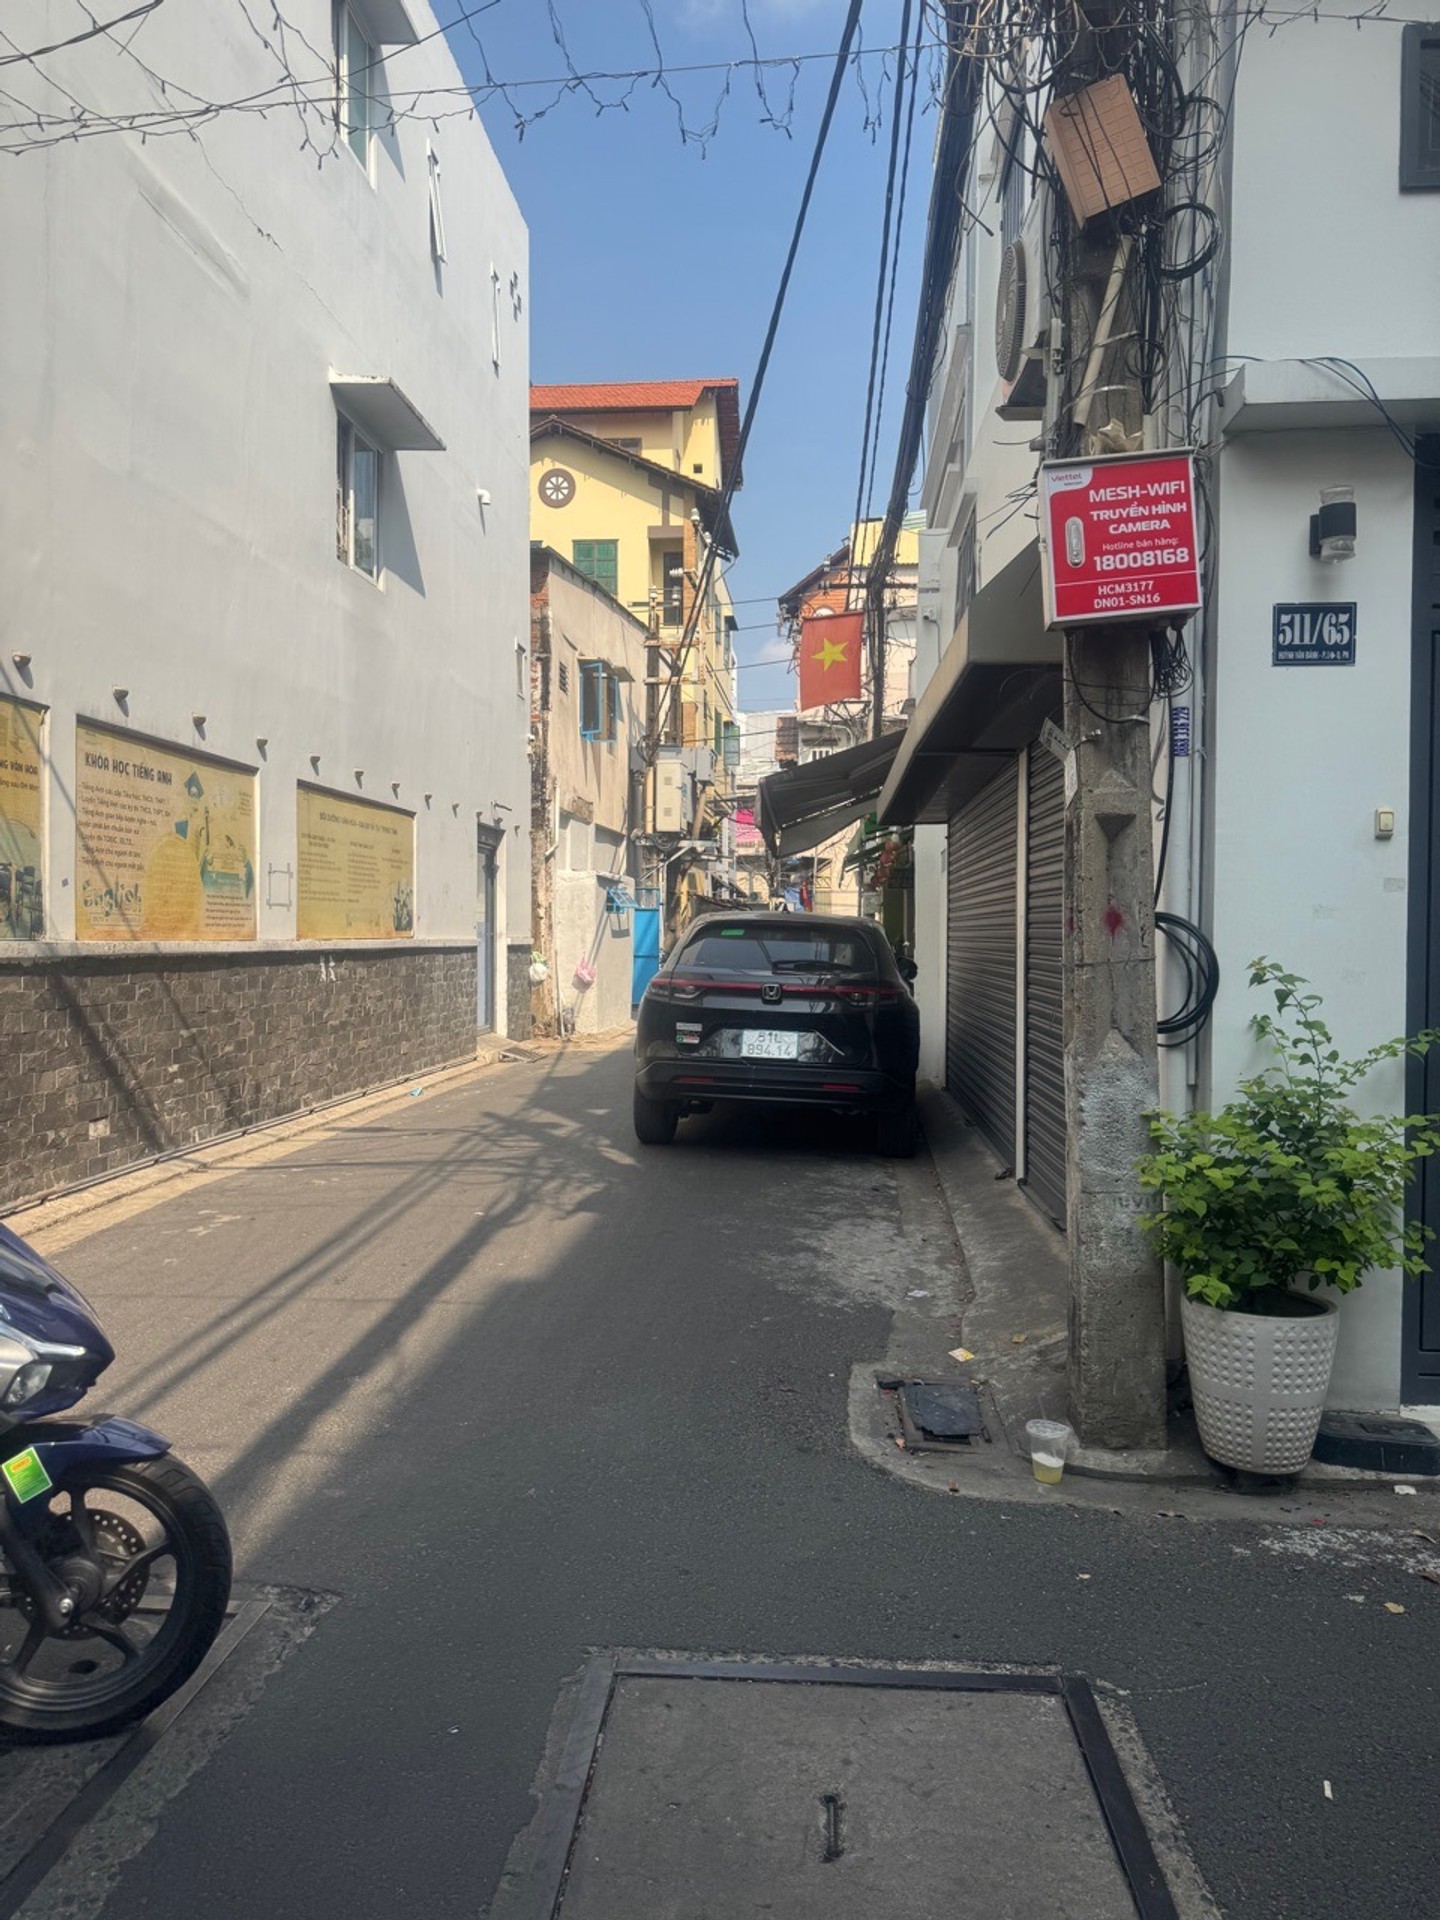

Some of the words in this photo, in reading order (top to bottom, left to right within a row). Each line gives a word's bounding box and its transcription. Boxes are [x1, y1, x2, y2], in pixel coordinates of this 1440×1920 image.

[1089, 480, 1185, 503] MESH-WIFI
[1090, 501, 1149, 521] TRUYỀN
[1151, 501, 1187, 515] HÌNH
[1109, 519, 1171, 535] CAMERA
[1102, 542, 1134, 552] Hotline
[1136, 539, 1153, 548] bán
[1093, 547, 1189, 572] 18008168
[1098, 581, 1154, 596] HCM3177
[1093, 593, 1161, 609] DN01-SN16
[1278, 612, 1350, 646] 511/65
